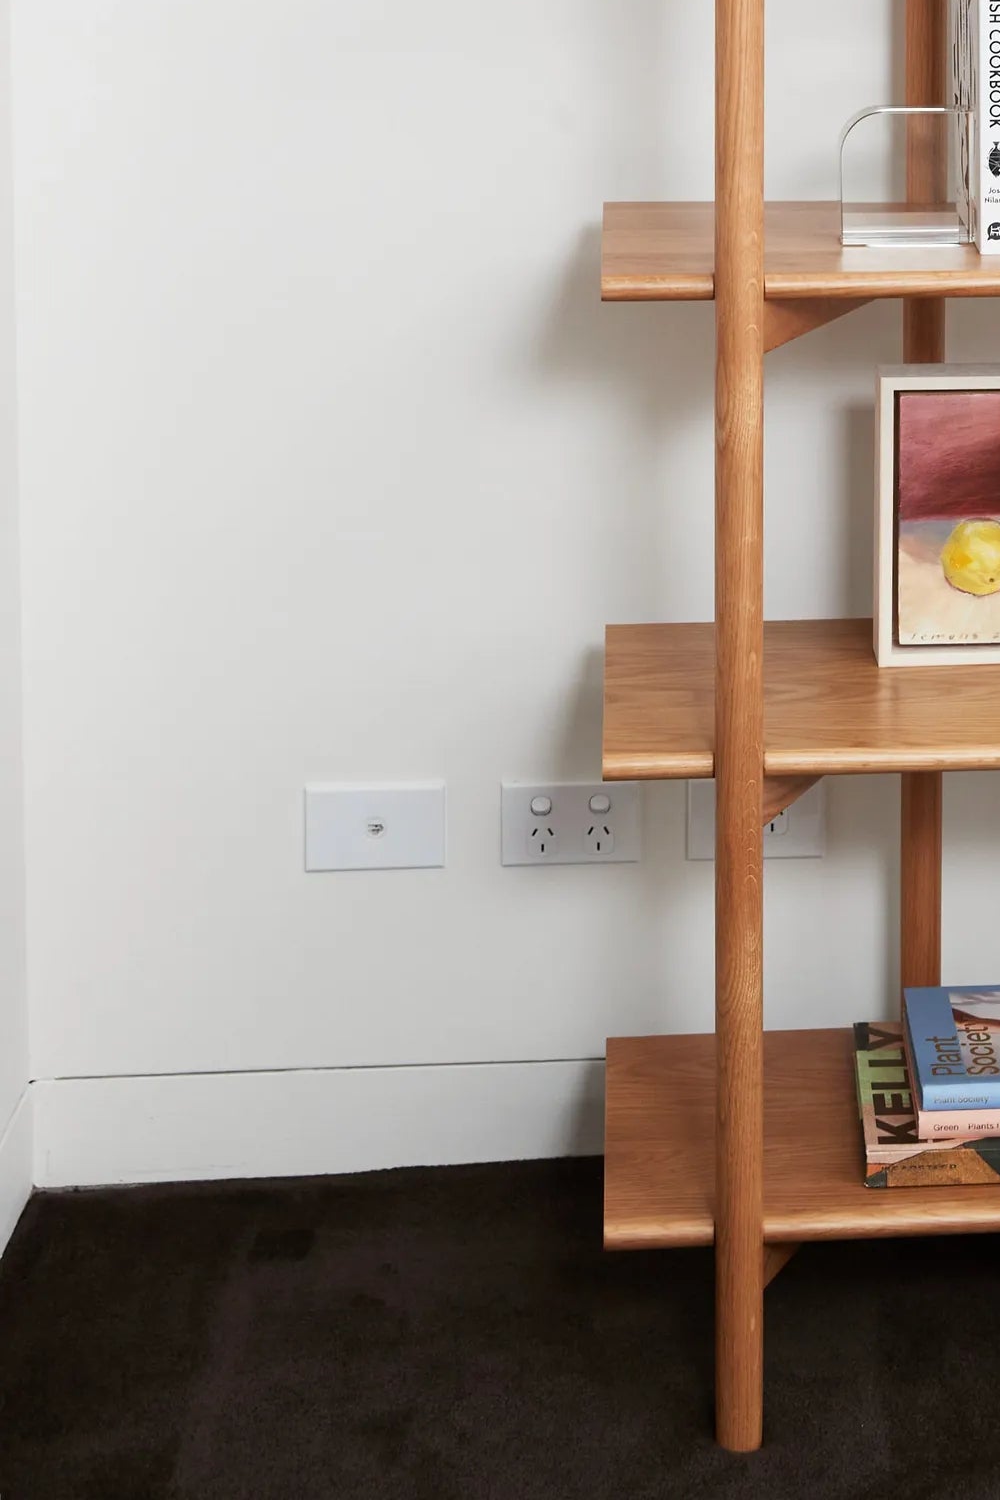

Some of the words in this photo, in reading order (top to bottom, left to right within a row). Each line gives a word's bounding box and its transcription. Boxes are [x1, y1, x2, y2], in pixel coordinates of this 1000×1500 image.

[926, 1035, 967, 1076] Plant
[866, 1025, 919, 1145] KELLY
[934, 1095, 955, 1104] Plant
[958, 1094, 989, 1105] Society
[933, 1123, 959, 1132] Green
[968, 1121, 994, 1130] Plants
